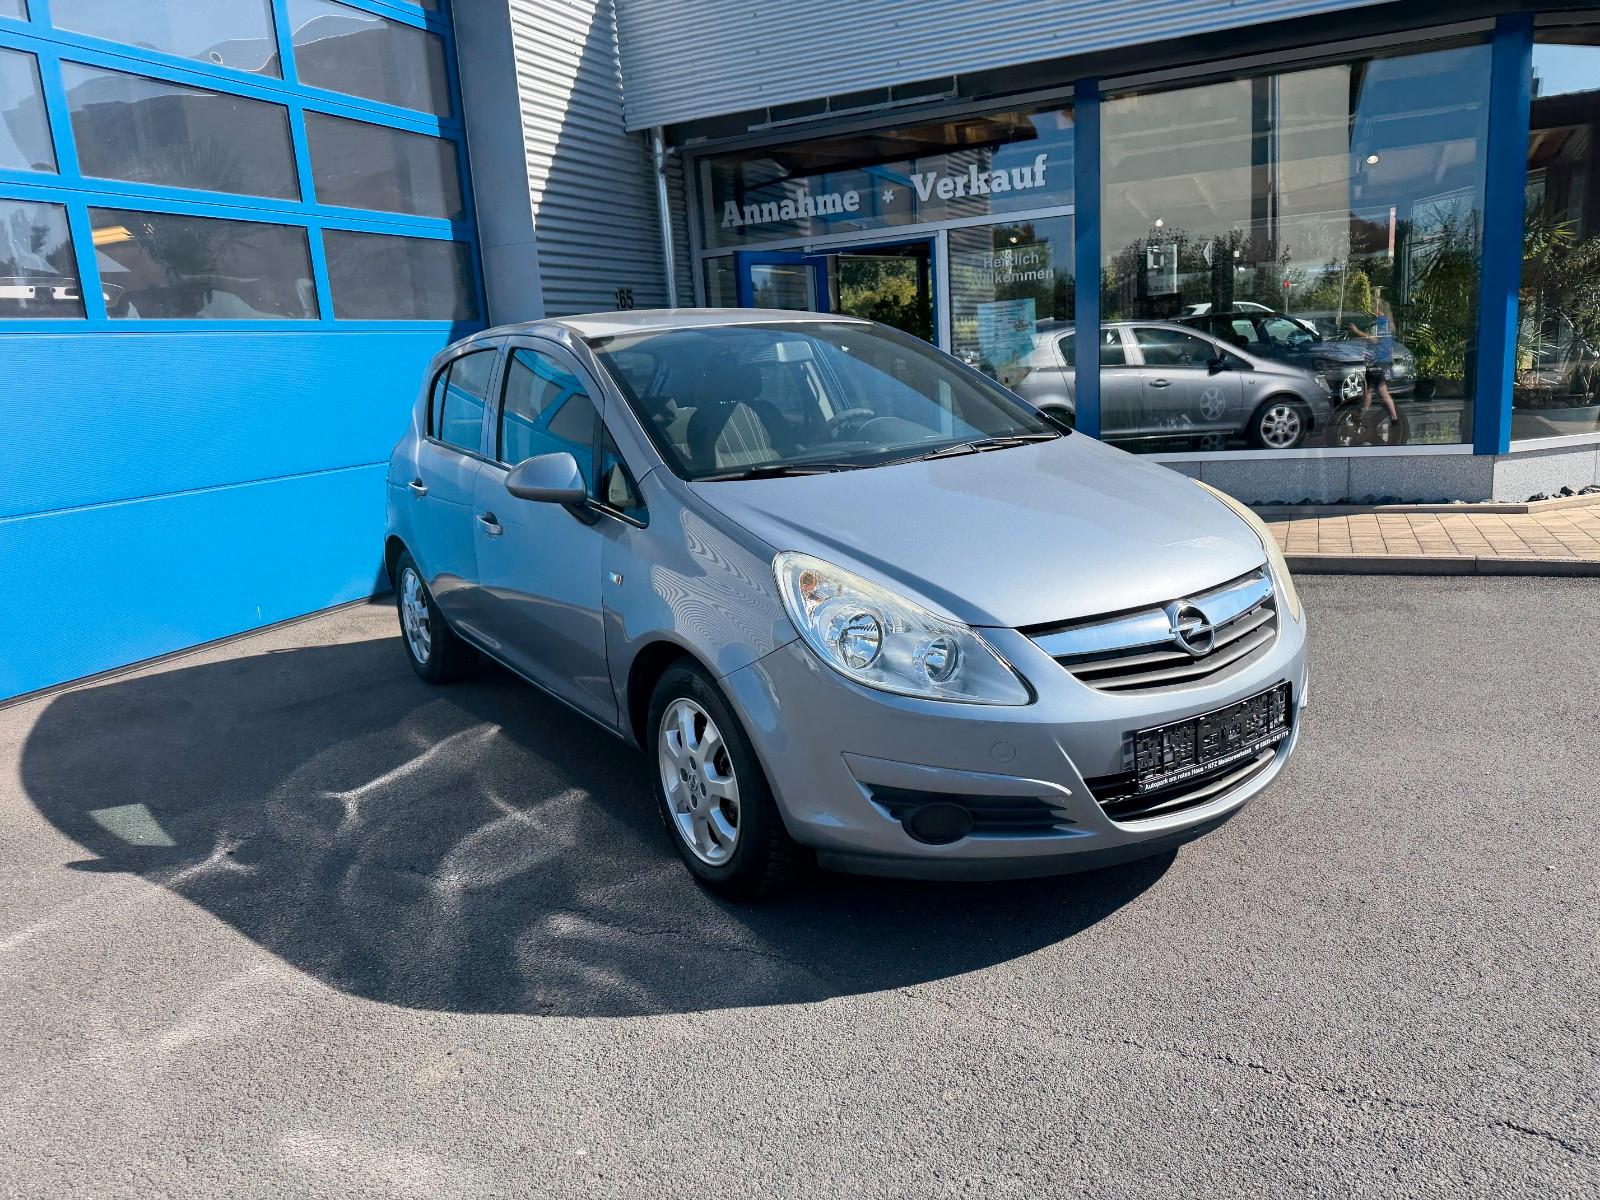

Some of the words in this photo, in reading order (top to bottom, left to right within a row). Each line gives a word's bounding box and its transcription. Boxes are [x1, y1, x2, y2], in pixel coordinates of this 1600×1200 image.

[721, 189, 860, 228] Annahme
[910, 154, 1048, 202] Verkauf
[1144, 778, 1169, 791] Autopark
